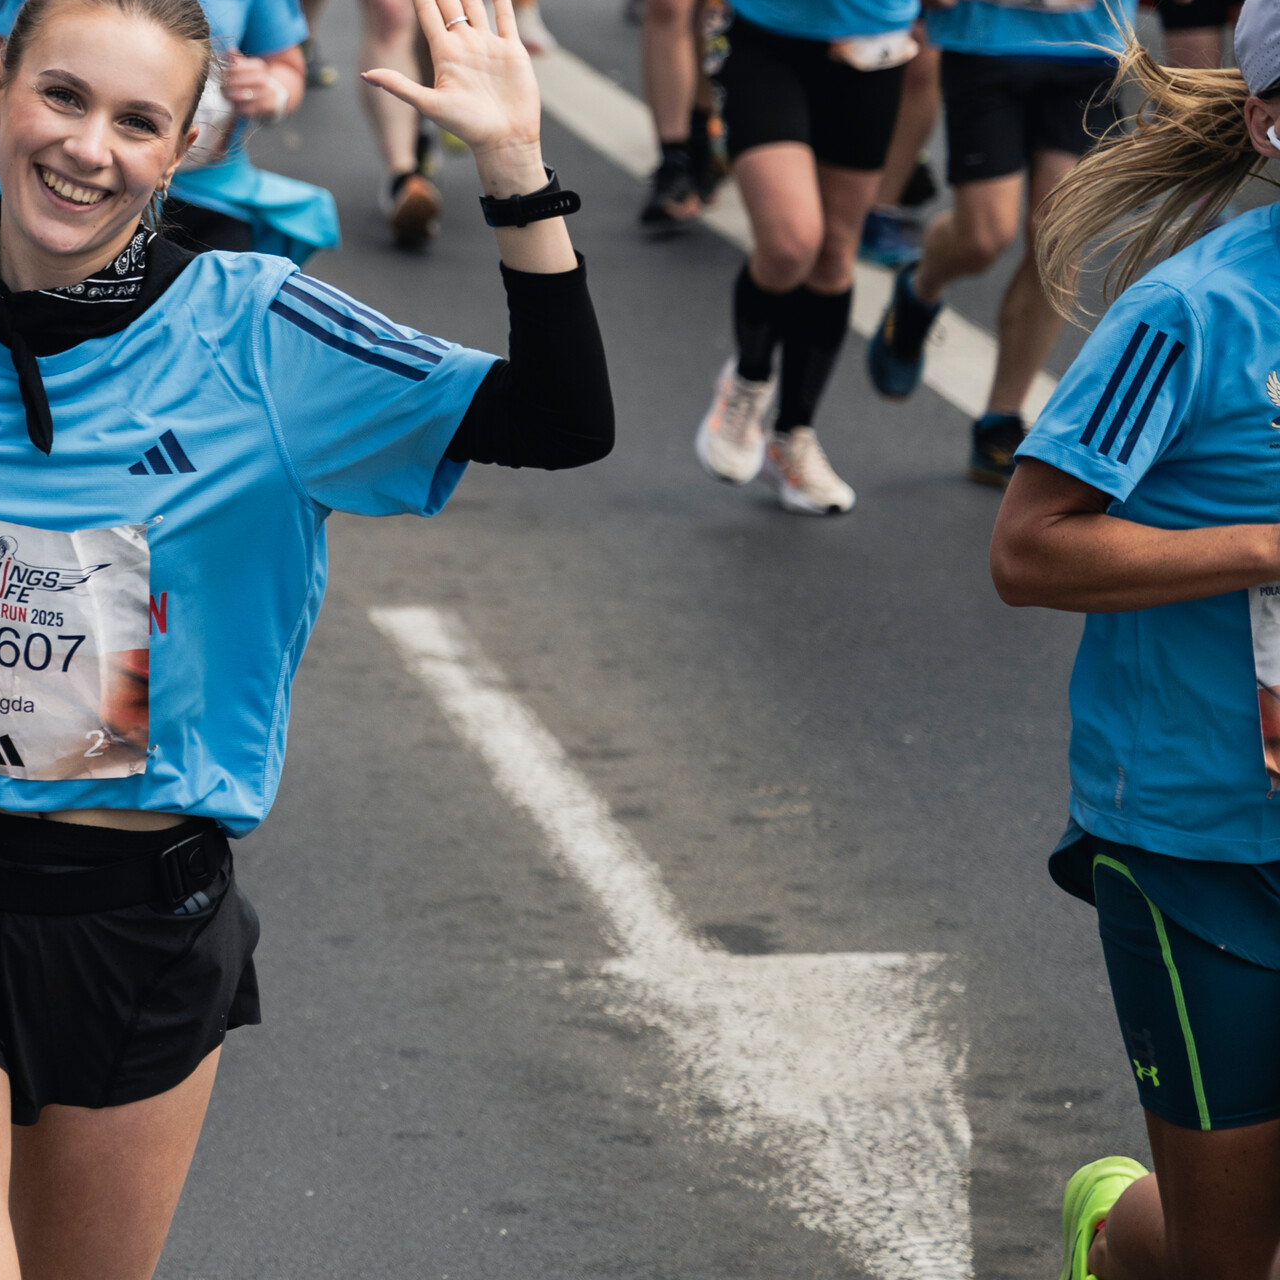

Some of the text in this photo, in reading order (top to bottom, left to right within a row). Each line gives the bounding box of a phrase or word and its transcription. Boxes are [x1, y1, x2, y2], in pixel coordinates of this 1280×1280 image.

[0, 602, 27, 624] RUN
[31, 609, 64, 627] 2025
[83, 729, 105, 758] 2
